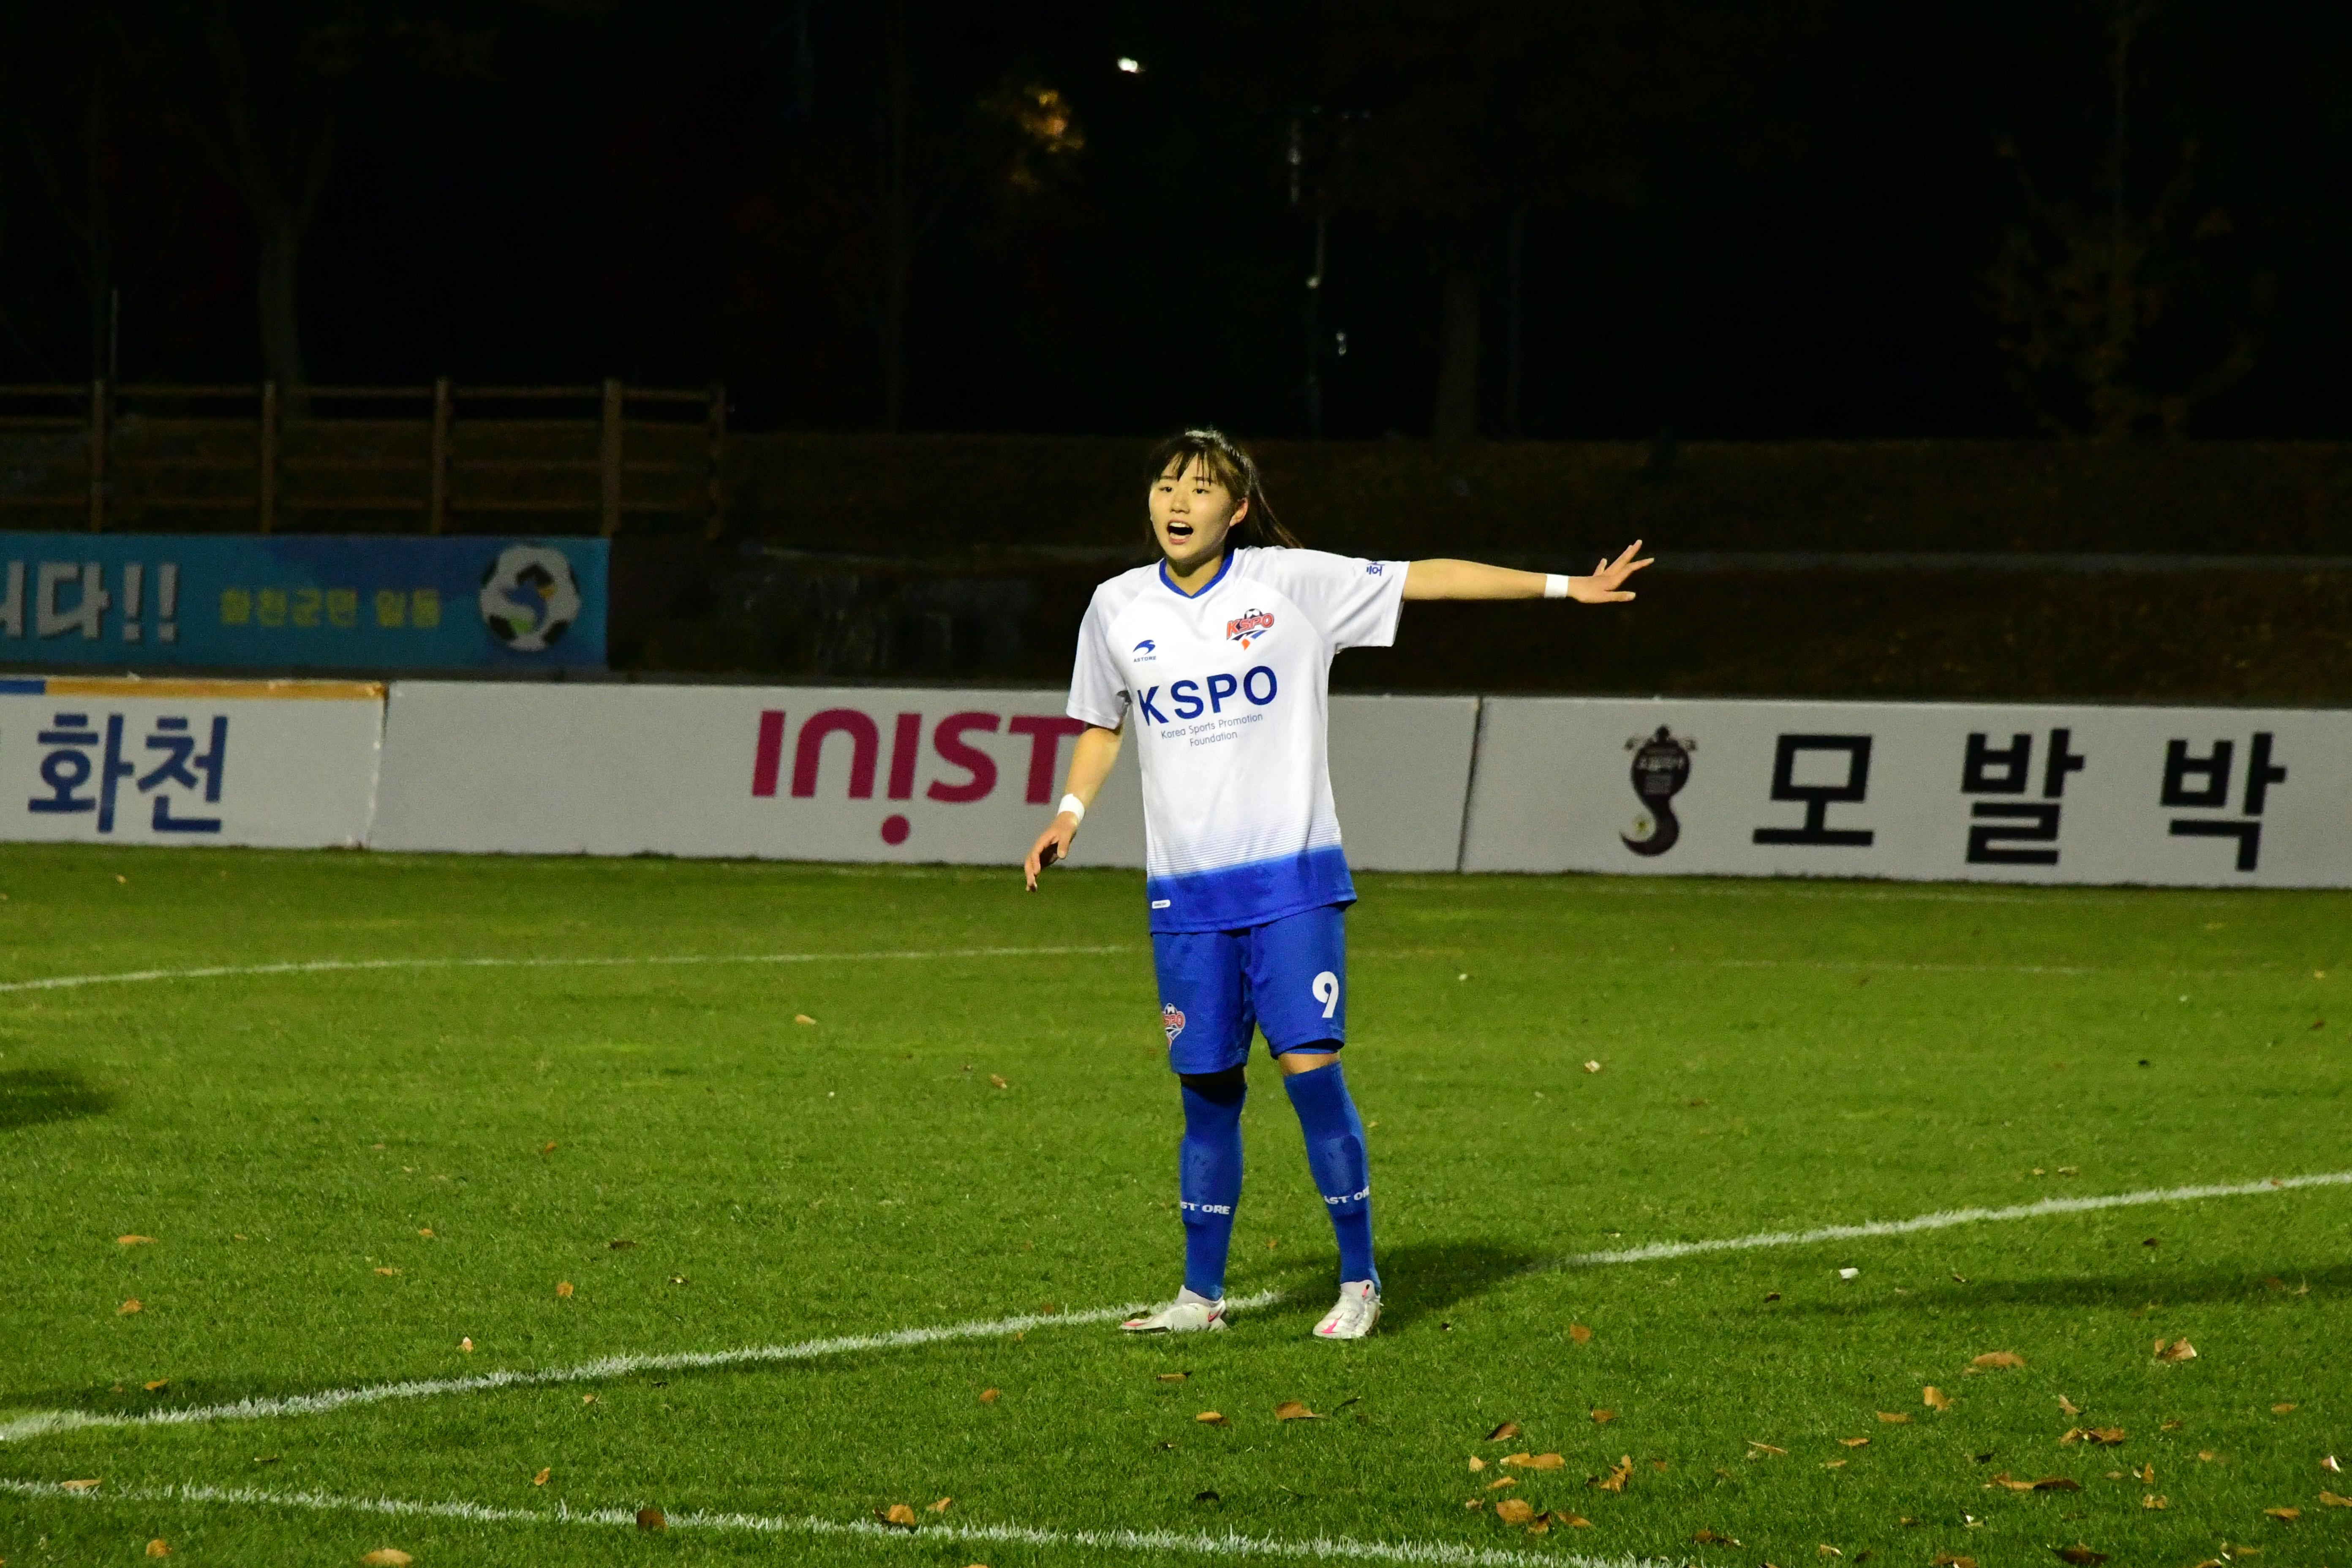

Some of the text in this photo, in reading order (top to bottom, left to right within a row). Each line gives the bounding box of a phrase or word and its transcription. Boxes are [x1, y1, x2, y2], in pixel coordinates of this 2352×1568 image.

[1226, 613, 1274, 640] KSPO
[1137, 665, 1277, 726] KSPO
[1161, 713, 1263, 740] Korea Sports Promotion
[1190, 731, 1238, 747] Foundation
[28, 713, 228, 833] 화천
[1312, 971, 1339, 1018] 9
